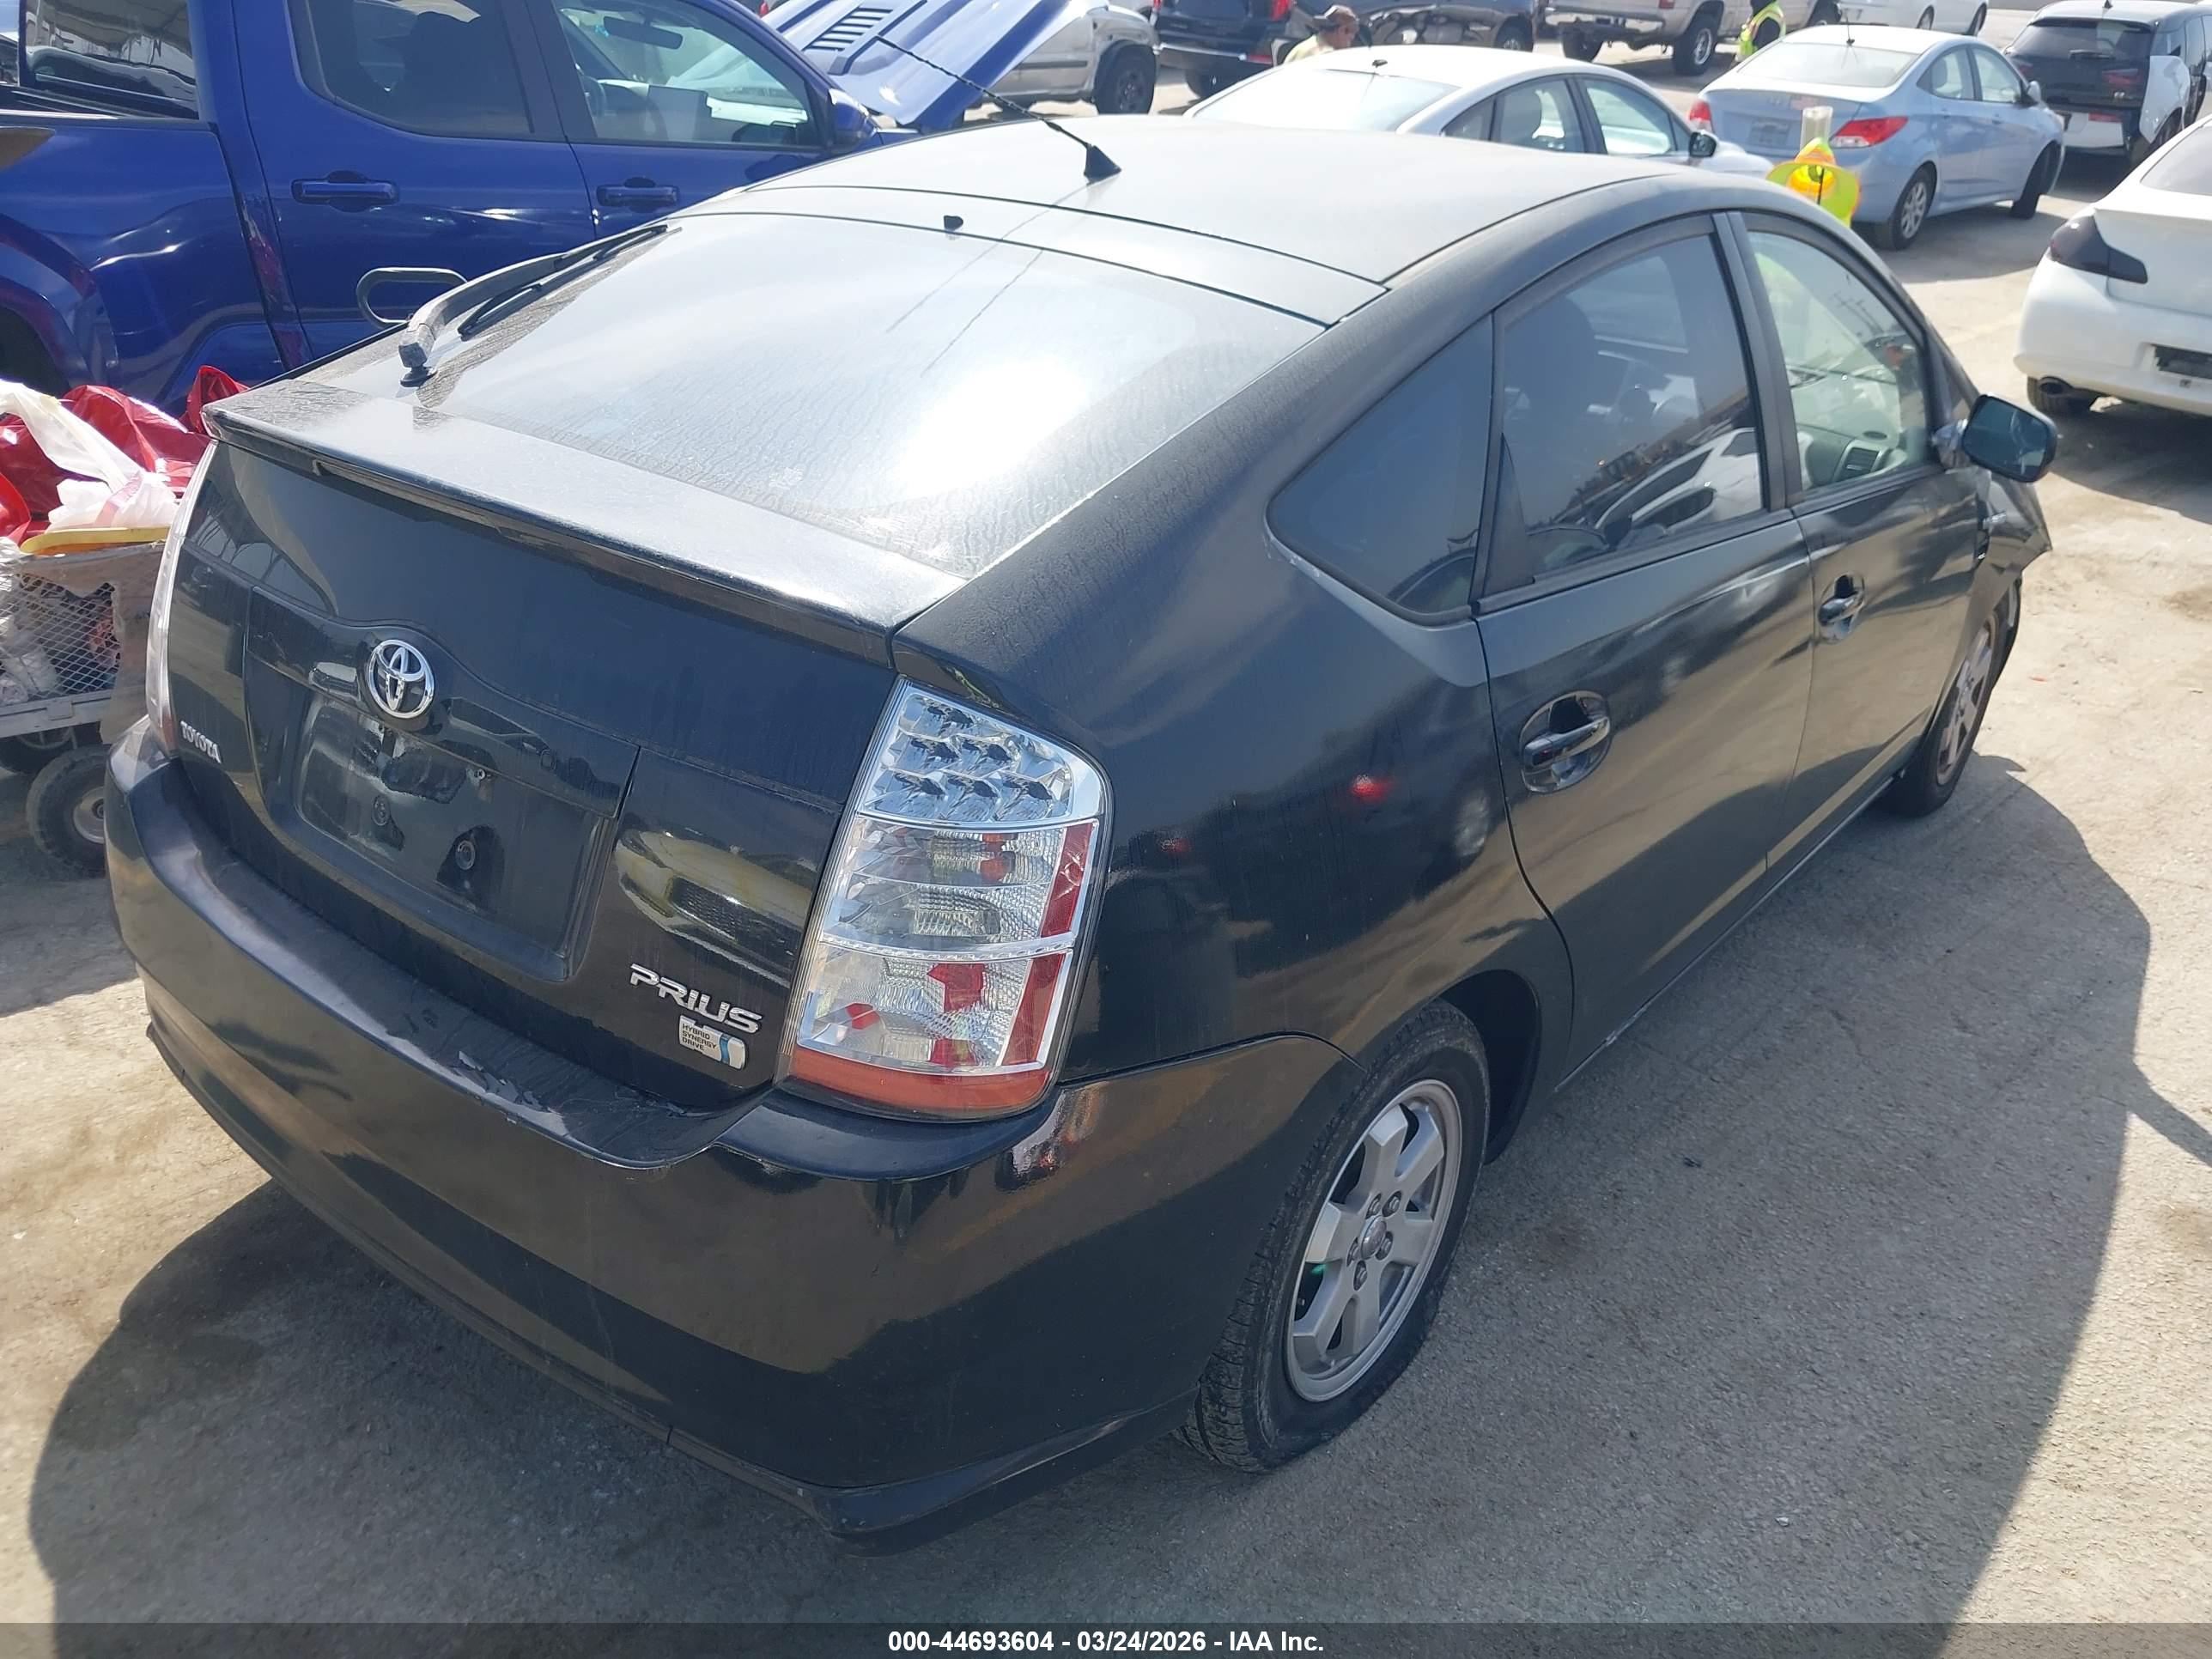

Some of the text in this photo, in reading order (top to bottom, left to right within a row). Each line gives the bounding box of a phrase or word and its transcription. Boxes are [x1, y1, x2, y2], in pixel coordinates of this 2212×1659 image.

[180, 720, 221, 763] TOYOTA
[629, 963, 763, 1034] PRIUS
[682, 1023, 710, 1040] HYBRID
[682, 1030, 716, 1048] SYNERGY
[682, 1037, 704, 1050] DRIVE
